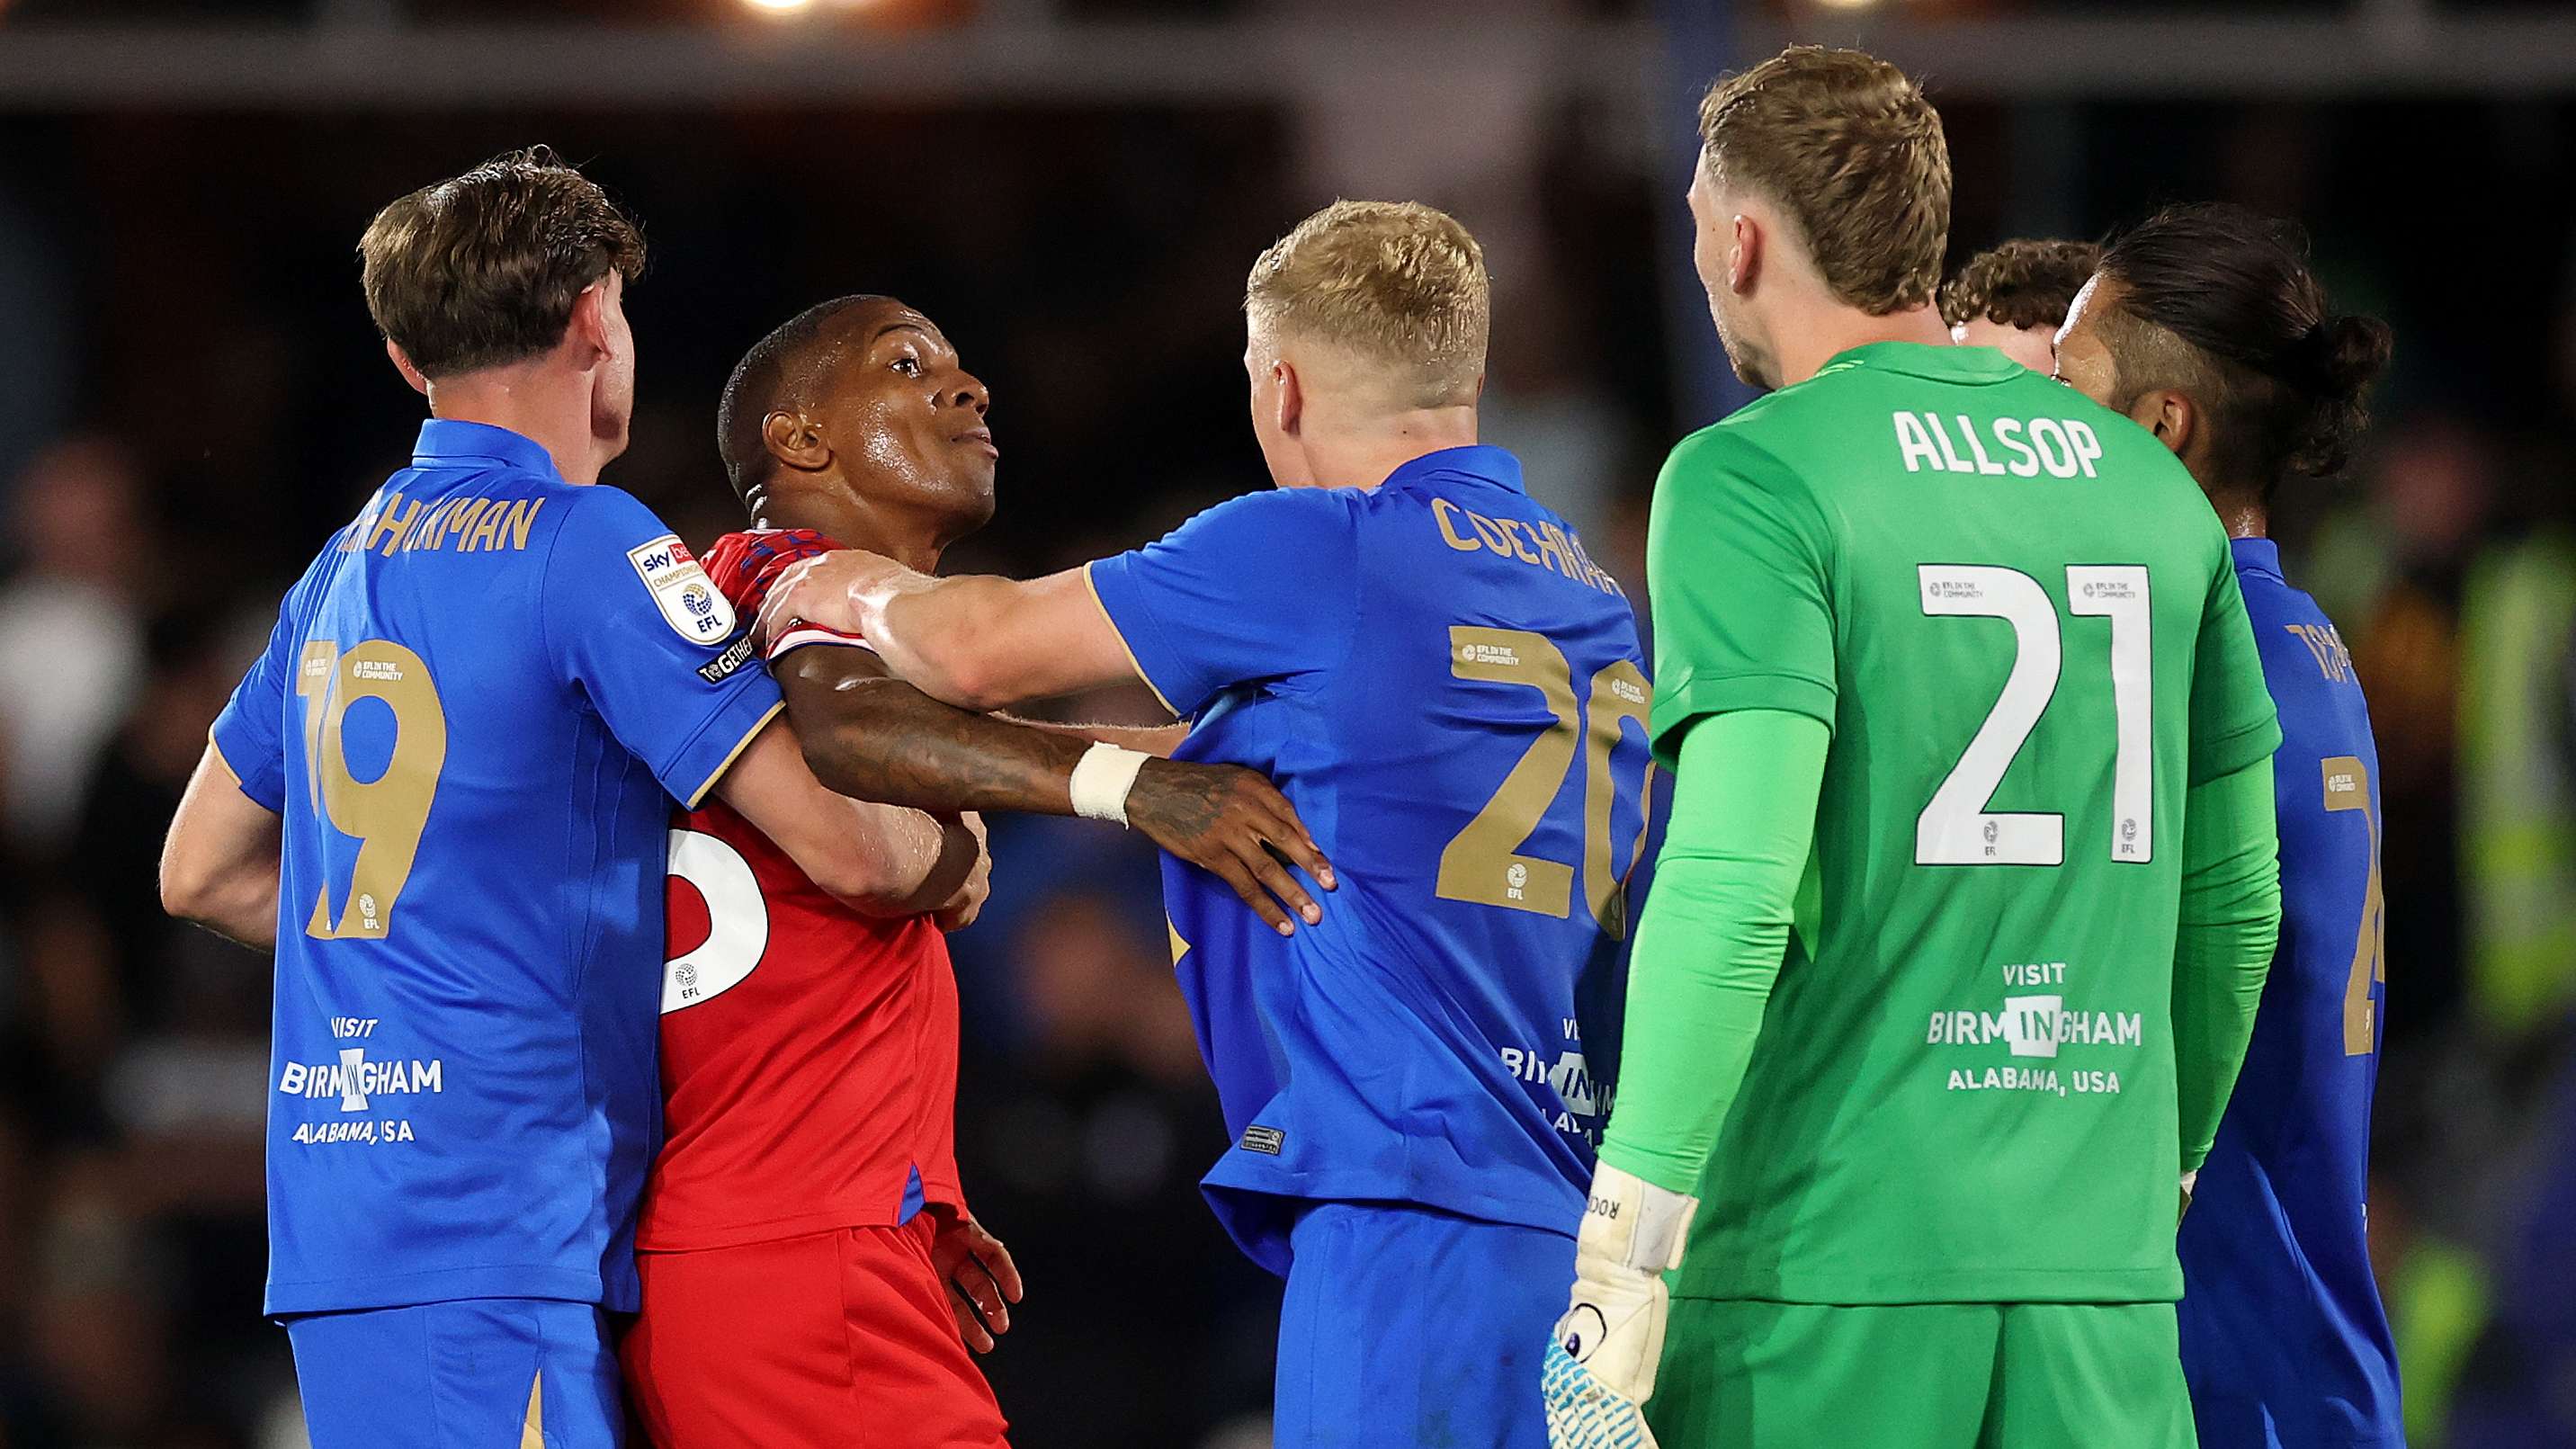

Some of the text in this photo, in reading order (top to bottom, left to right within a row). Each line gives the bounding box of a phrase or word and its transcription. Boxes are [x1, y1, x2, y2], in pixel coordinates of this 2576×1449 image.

[1892, 411, 2103, 479] ALLSOP
[643, 550, 670, 572] sky
[697, 615, 722, 633] EFL
[1915, 564, 2153, 866] 21
[296, 640, 447, 939] 19
[1436, 626, 1657, 940] 20
[2122, 844, 2134, 854] EFL
[363, 918, 380, 929] EFL
[2002, 962, 2066, 986] VISIT
[682, 988, 701, 999] EFL
[331, 1017, 378, 1038] VISIT
[1927, 1010, 2142, 1046] BIRMINGHAM
[279, 1060, 443, 1099] BIRMINGHAM
[1947, 1068, 2120, 1097] ALABAMA, USA
[292, 1122, 378, 1145] ALABAMA,
